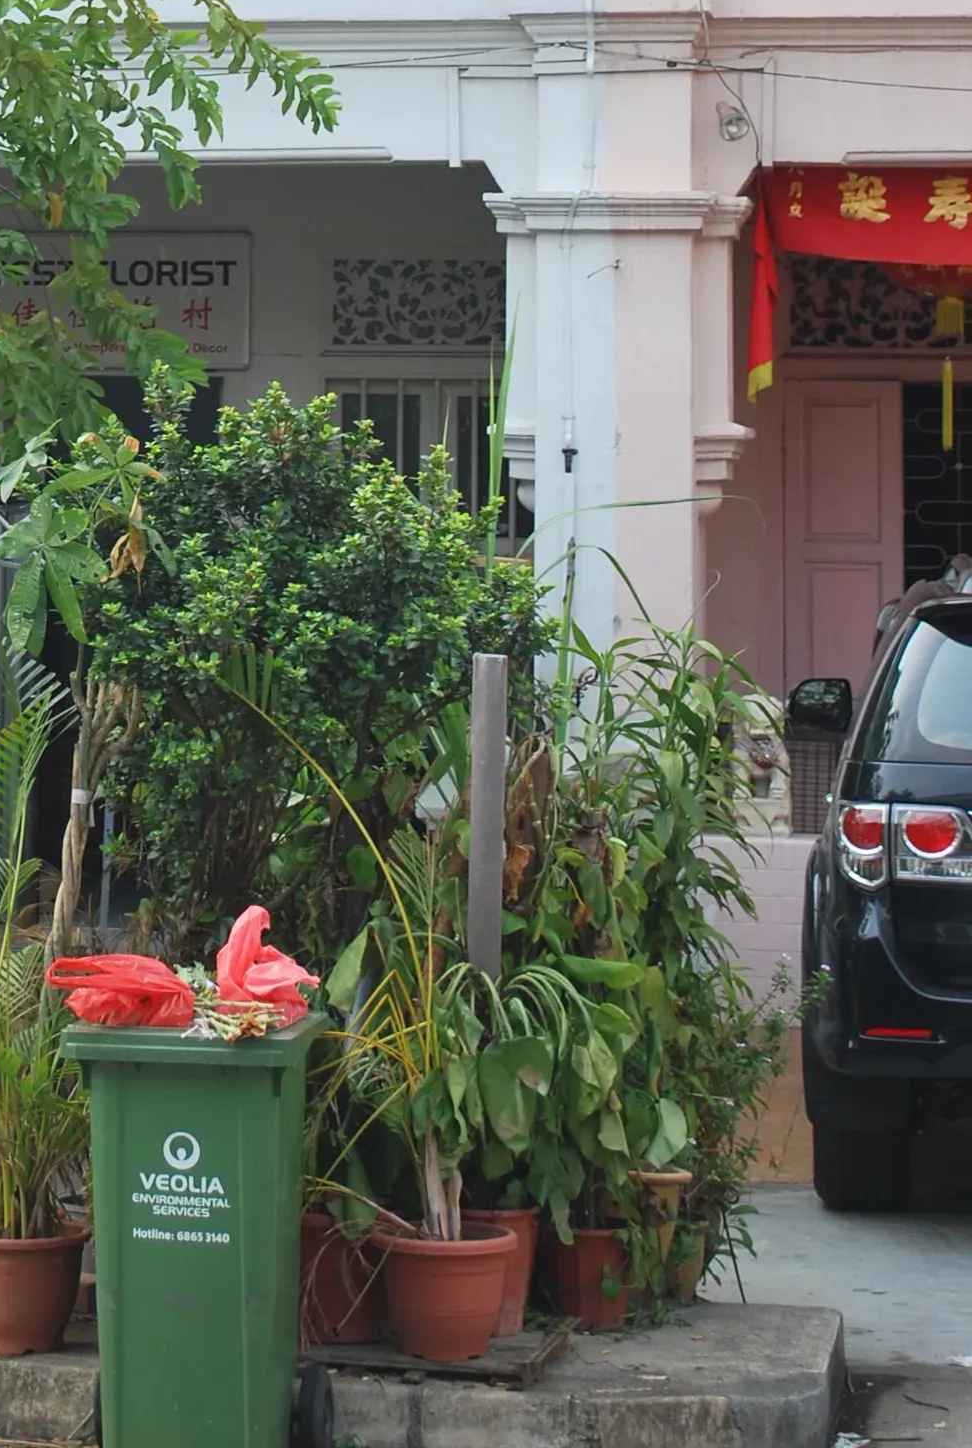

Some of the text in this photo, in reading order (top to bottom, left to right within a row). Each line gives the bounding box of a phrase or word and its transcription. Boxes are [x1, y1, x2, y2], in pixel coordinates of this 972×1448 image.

[139, 1172, 224, 1194] VEOLIA
[132, 1193, 231, 1208] ENVIRONMENTAL
[153, 1205, 210, 1218] SERVICES
[132, 1227, 231, 1244] Hotline: 6865 3140
